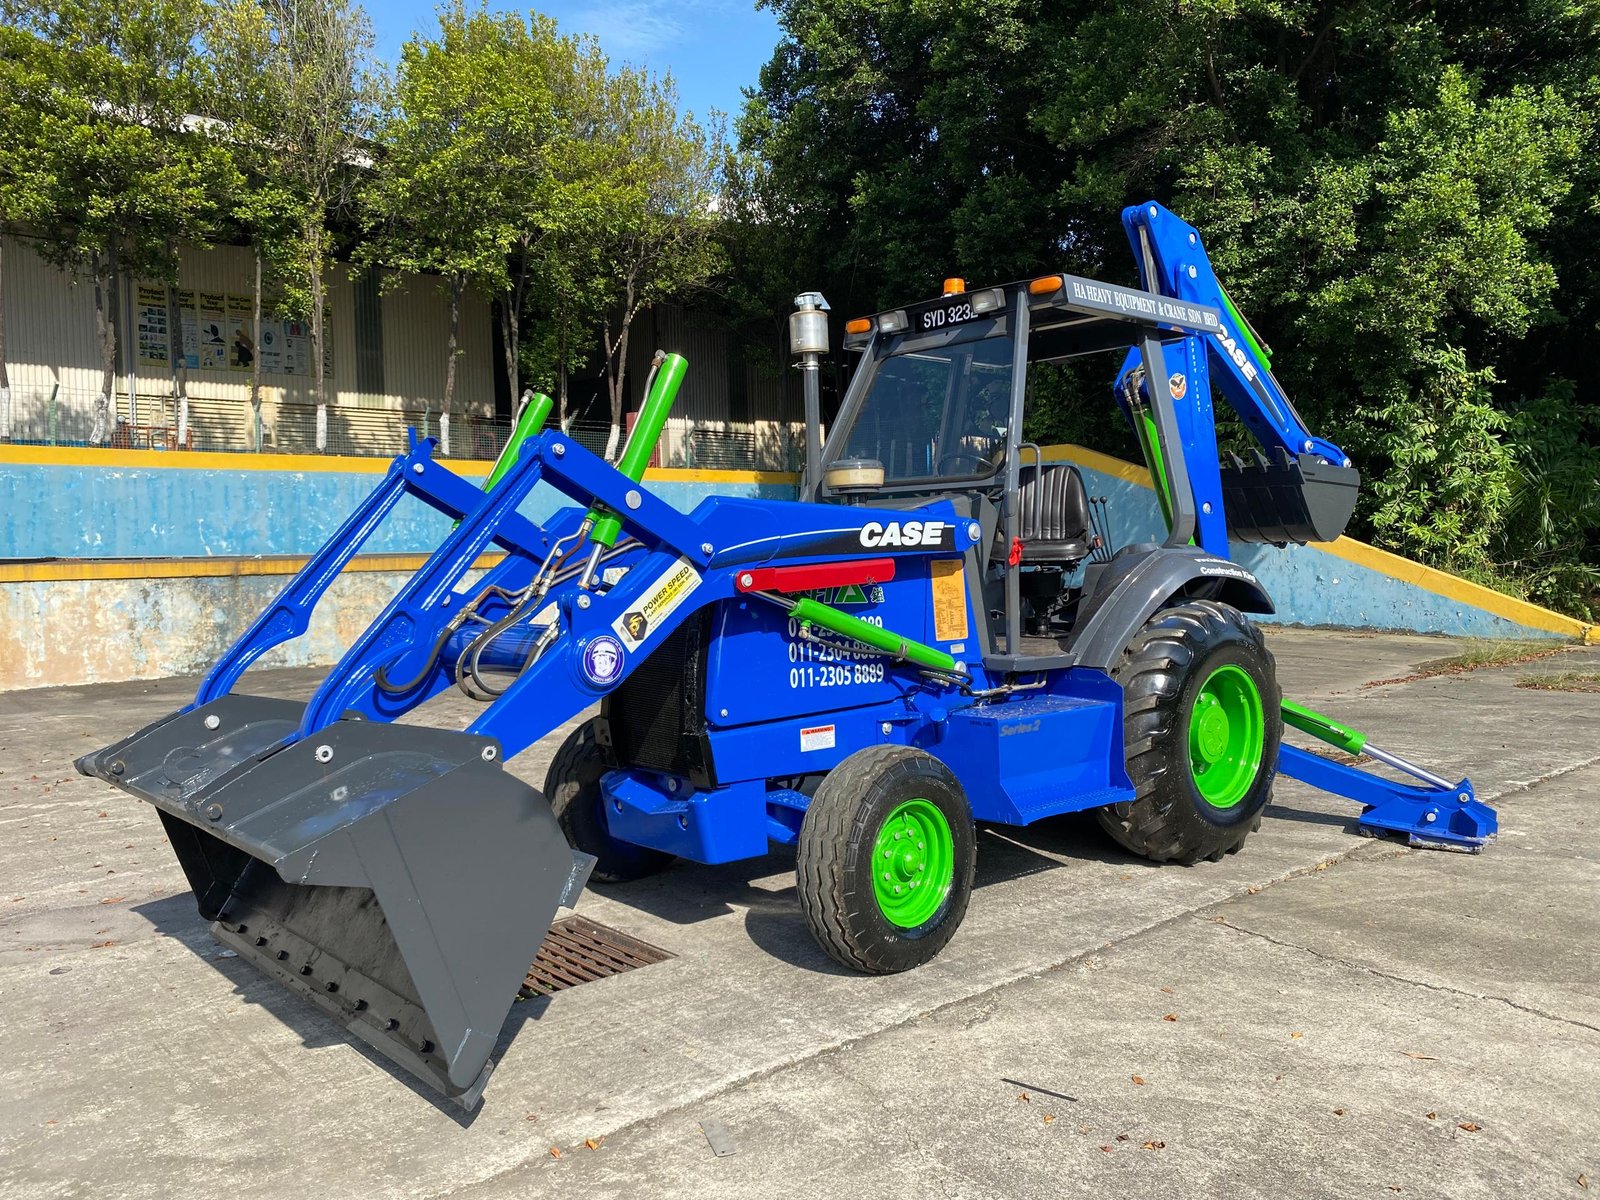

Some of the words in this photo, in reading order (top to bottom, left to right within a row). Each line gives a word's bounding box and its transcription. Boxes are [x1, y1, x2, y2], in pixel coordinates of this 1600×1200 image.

[139, 286, 165, 296] Protect
[200, 292, 224, 300] Protect
[1073, 282, 1087, 299] HA
[1086, 286, 1112, 305] HEAVY
[1114, 291, 1157, 314] EQUIPMENT
[1158, 302, 1165, 316] &
[1164, 303, 1188, 321] CRANE
[1188, 308, 1202, 324] SDN
[1203, 311, 1218, 327] BHD
[923, 309, 945, 328] SYD
[1215, 323, 1258, 382] CASE
[859, 521, 945, 547] CASE
[1200, 566, 1243, 577] Construction
[643, 587, 668, 614] POWER
[667, 566, 689, 590] SPEED
[790, 665, 852, 688] 011-2305
[854, 662, 884, 685] 8889
[1000, 723, 1032, 737] Series
[1032, 719, 1041, 731] 2
